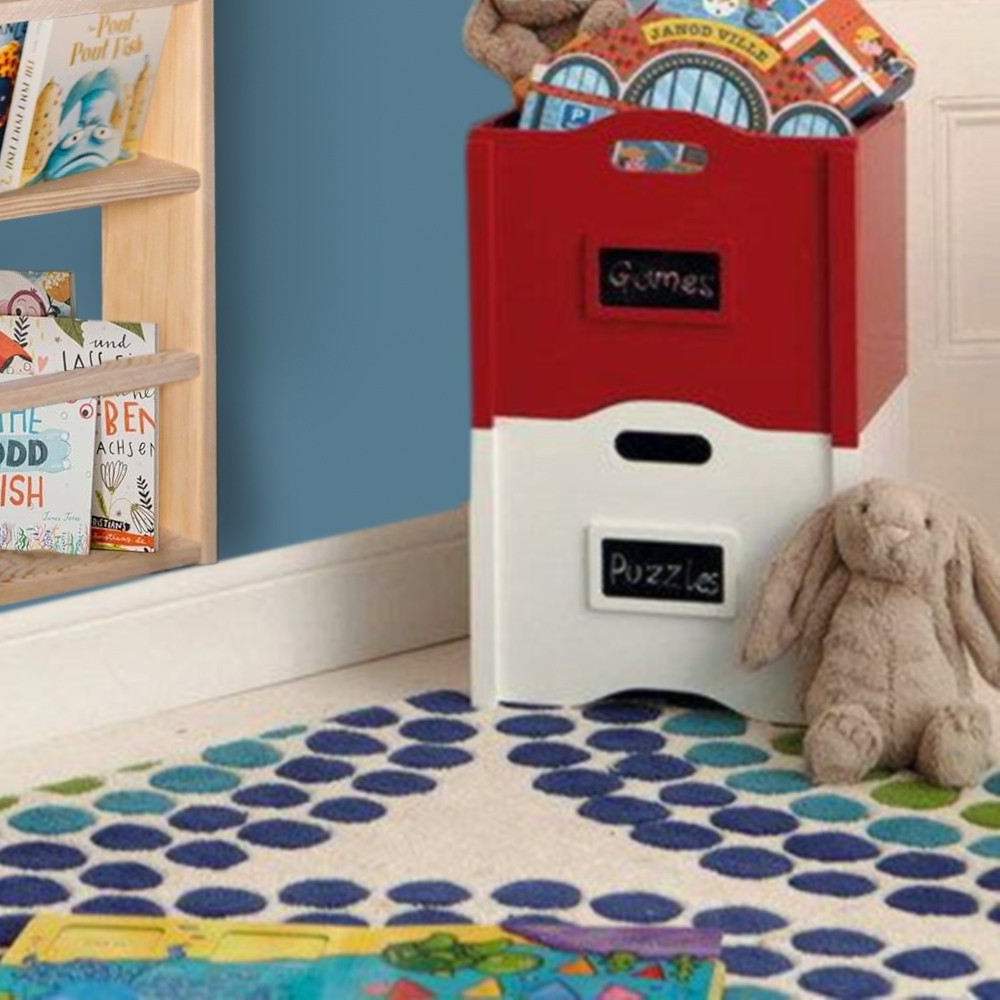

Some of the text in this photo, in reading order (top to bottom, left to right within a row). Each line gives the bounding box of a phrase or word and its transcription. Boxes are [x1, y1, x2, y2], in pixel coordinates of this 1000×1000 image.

[608, 260, 715, 298] Games
[90, 334, 131, 348] und
[610, 552, 719, 595] Puzzles
